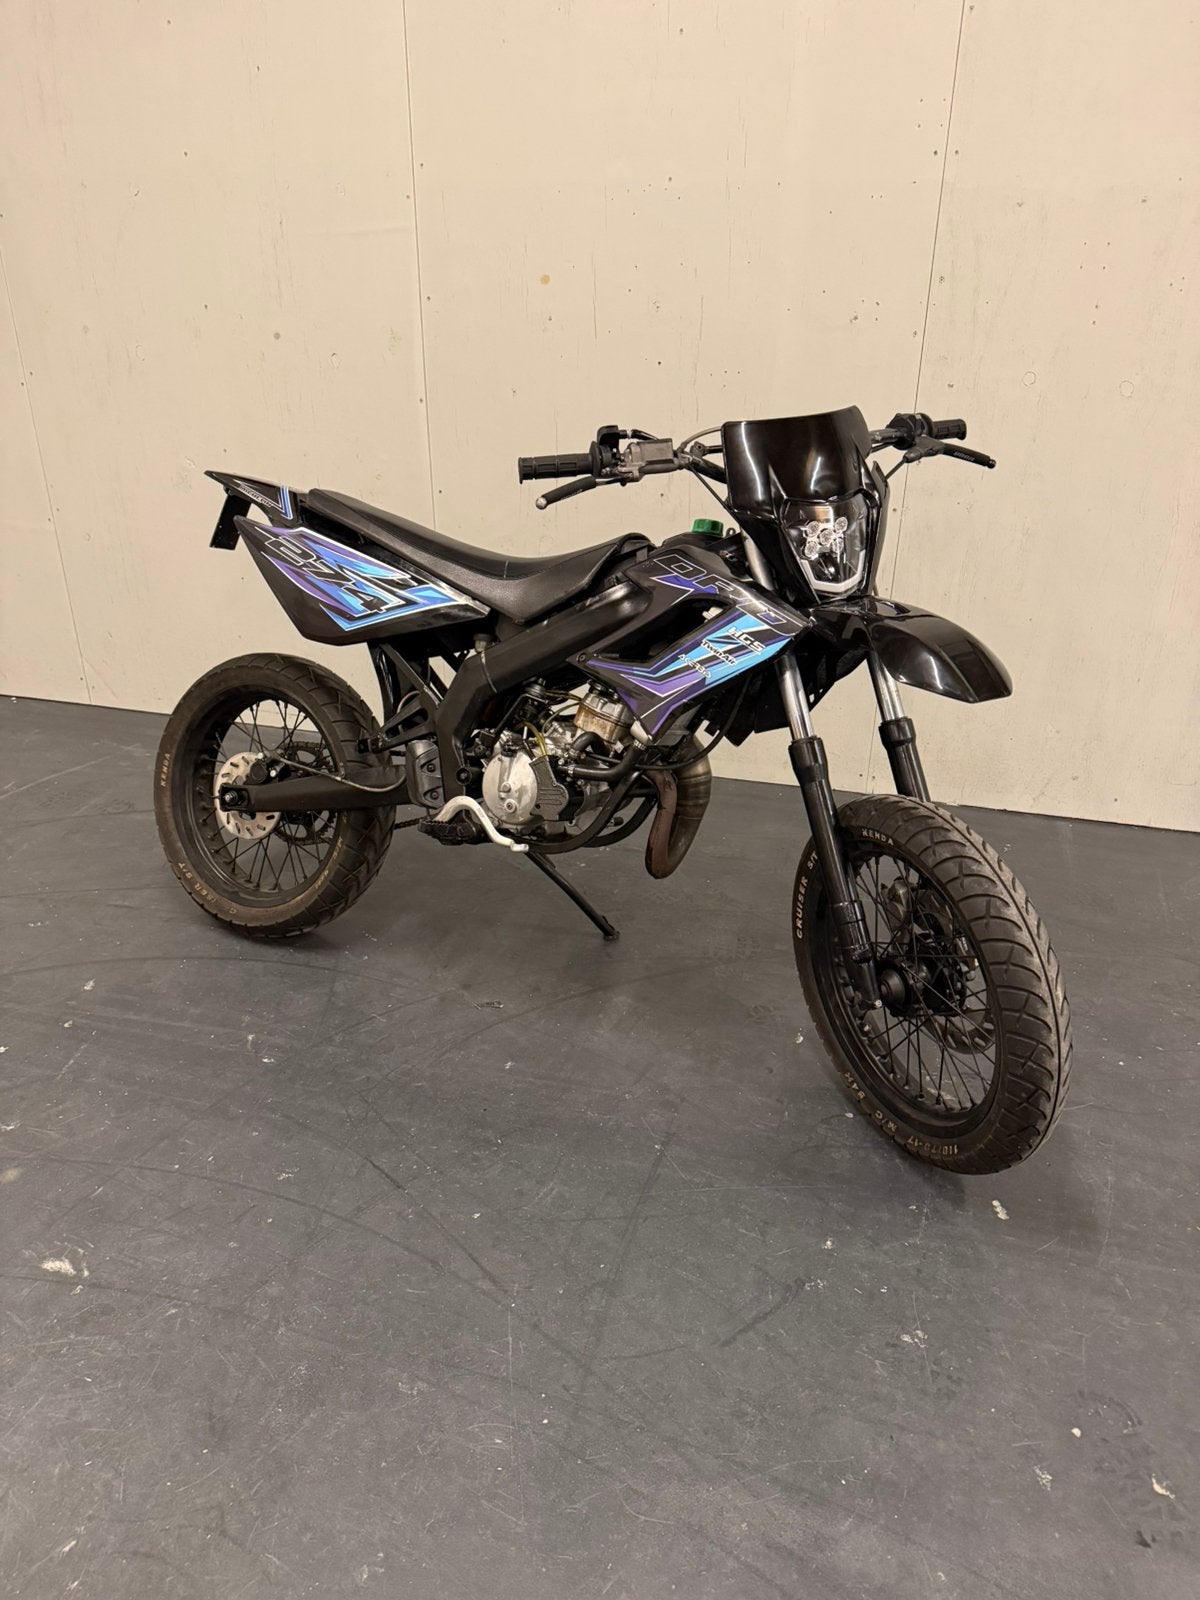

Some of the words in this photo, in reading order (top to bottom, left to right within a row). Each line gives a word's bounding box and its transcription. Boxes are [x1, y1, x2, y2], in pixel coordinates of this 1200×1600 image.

[728, 626, 766, 655] HGS
[160, 753, 171, 787] KENDA
[861, 828, 894, 846] KENDA
[795, 876, 808, 939] CRUISER
[807, 850, 819, 870] S/T
